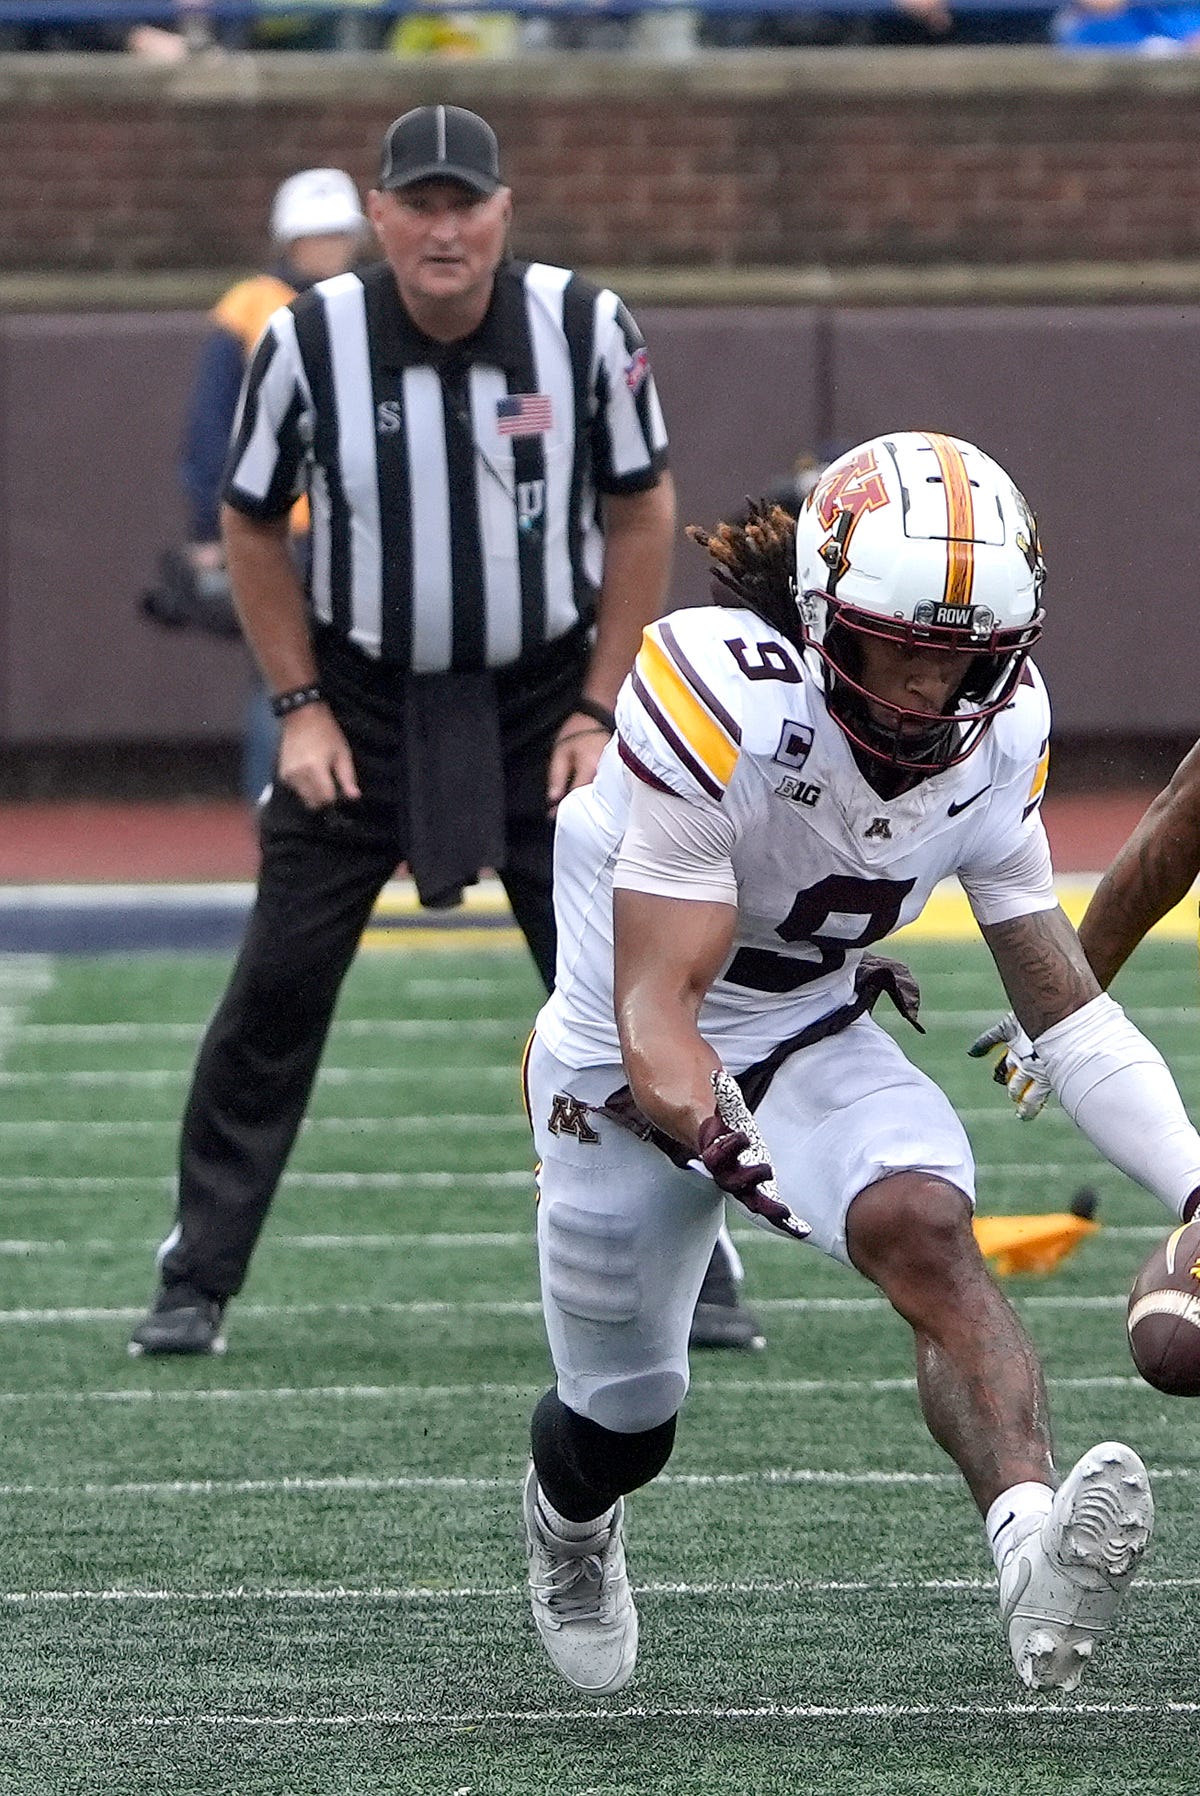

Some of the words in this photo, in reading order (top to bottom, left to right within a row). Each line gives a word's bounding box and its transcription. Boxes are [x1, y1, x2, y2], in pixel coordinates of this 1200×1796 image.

[937, 607, 971, 625] ROW
[724, 638, 803, 684] 9
[722, 873, 918, 993] 9
[547, 1094, 602, 1145] M
